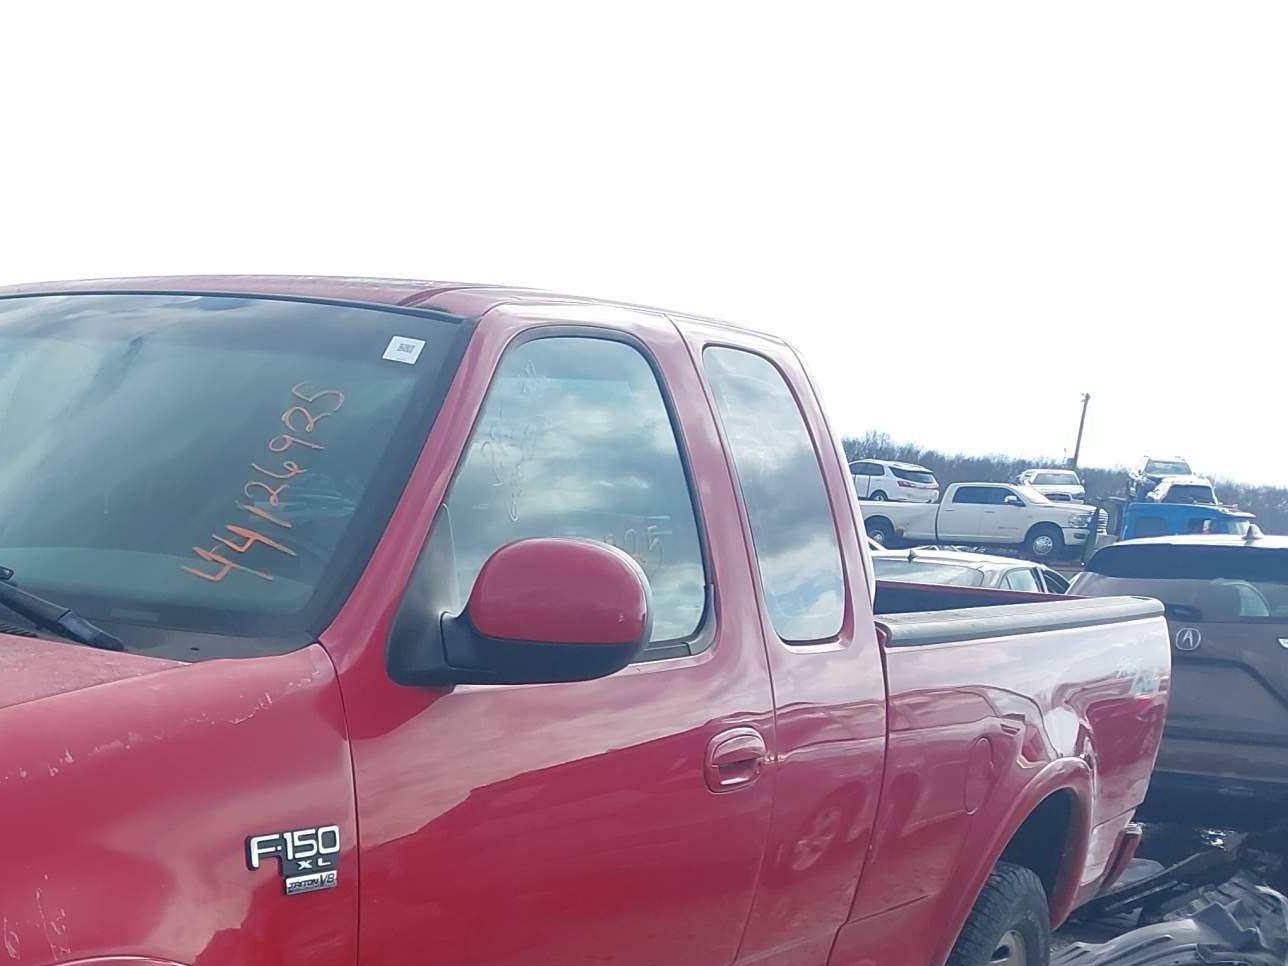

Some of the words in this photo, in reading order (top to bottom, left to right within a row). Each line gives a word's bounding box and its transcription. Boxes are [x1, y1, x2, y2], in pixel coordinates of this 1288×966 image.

[181, 380, 345, 581] 44126925
[250, 825, 340, 868] F-150
[297, 857, 332, 871] XL
